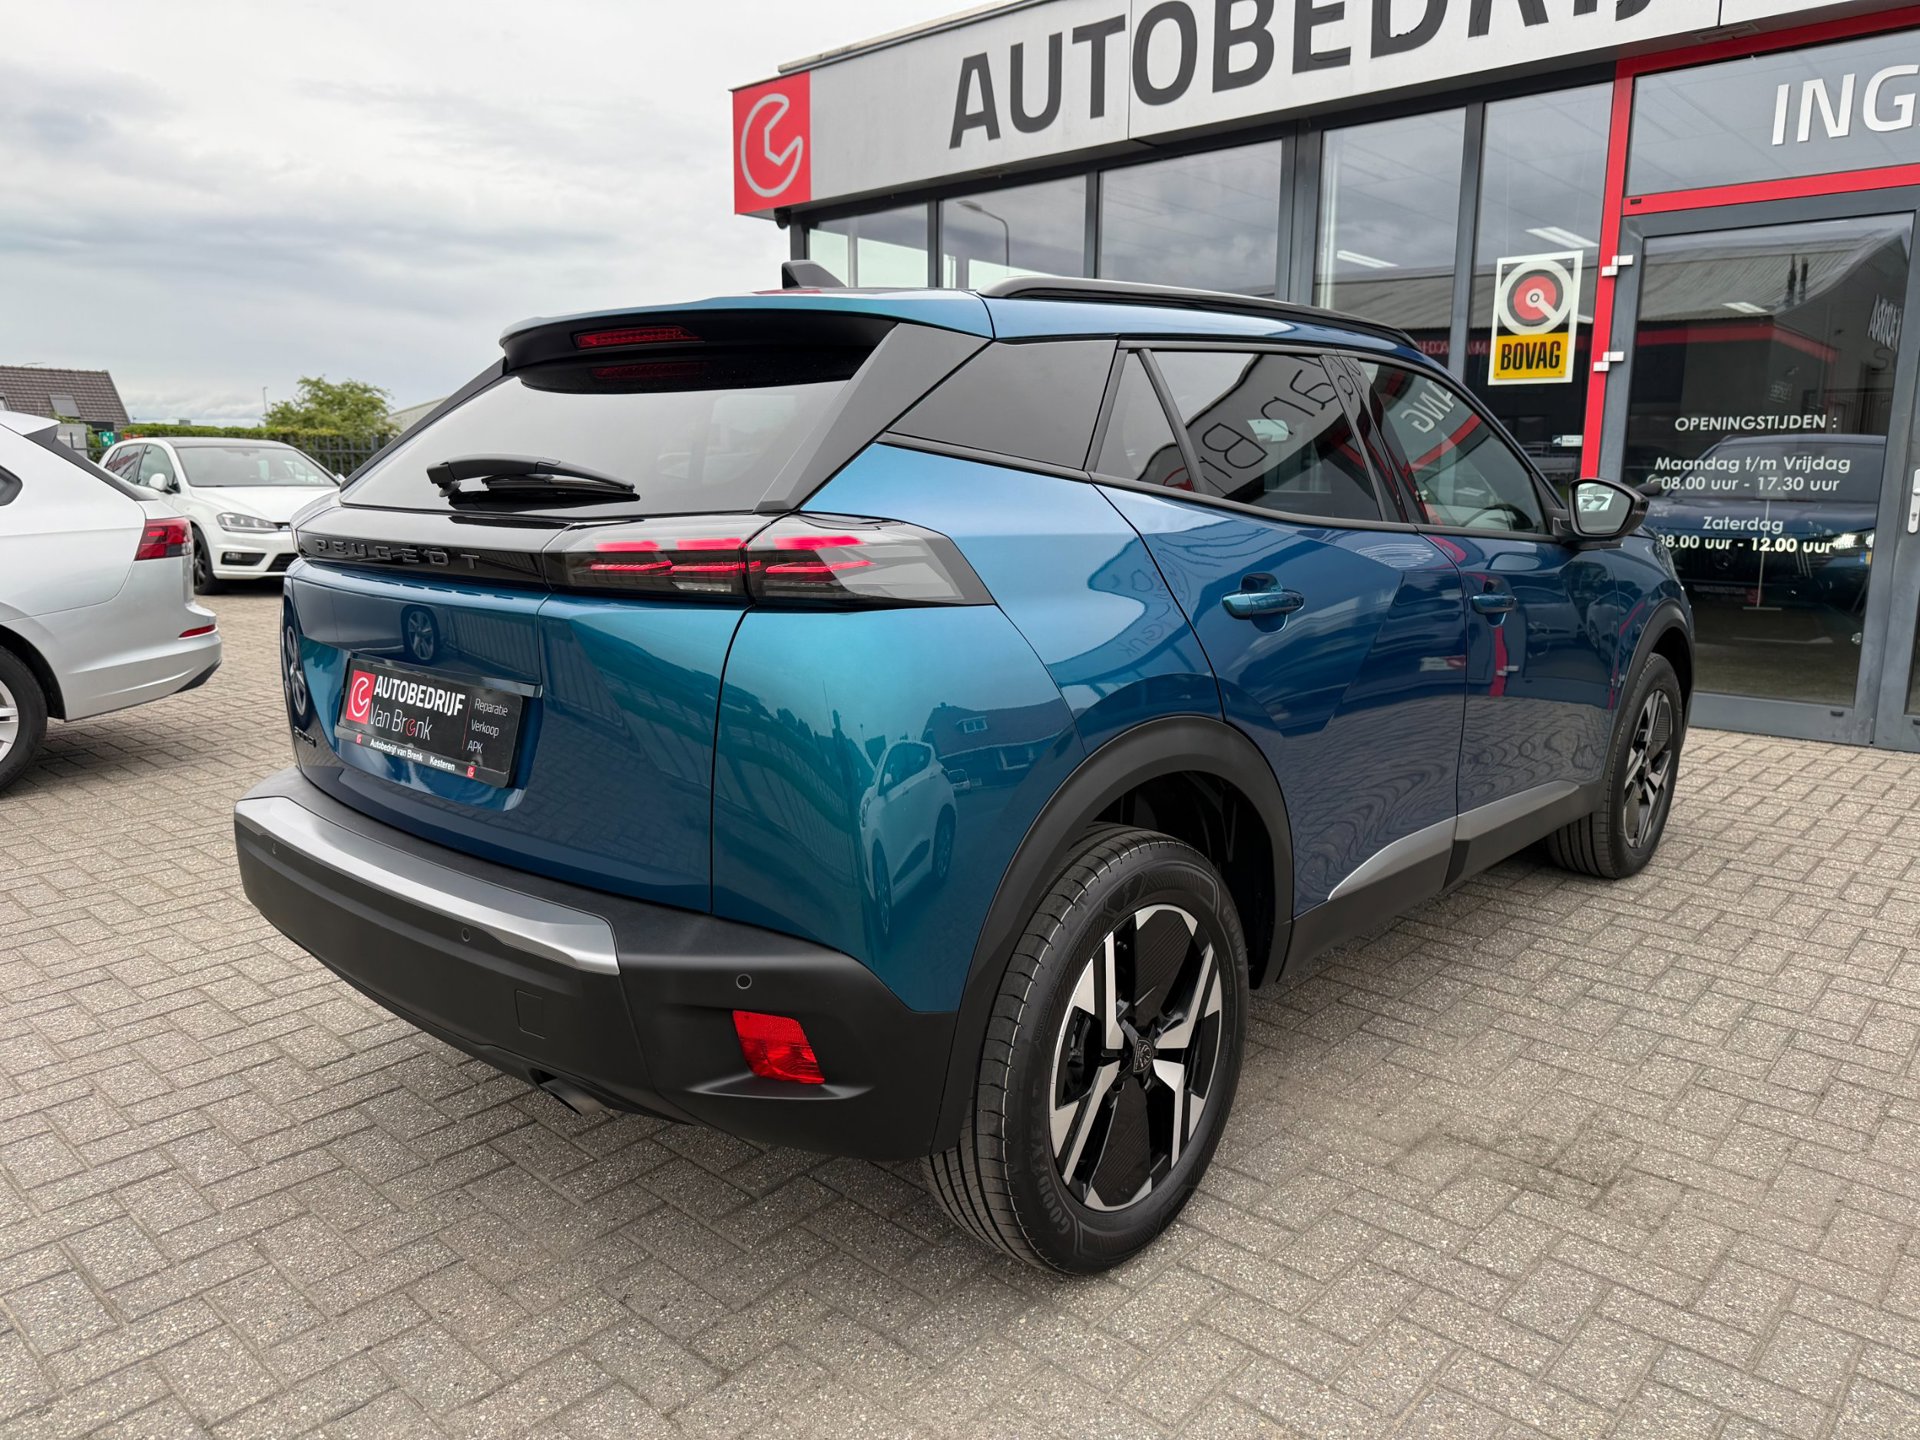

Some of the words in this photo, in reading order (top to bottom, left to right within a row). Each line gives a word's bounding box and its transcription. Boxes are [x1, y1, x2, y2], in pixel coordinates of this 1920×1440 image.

[948, 0, 1651, 150] AUTOBED
[1500, 339, 1561, 372] BOVAG
[1674, 414, 1827, 431] OPENINGSTIJDEN
[1654, 457, 1740, 474] Maandag
[1745, 457, 1777, 474] t/m
[1783, 457, 1851, 474] Vrijdag
[1661, 476, 1706, 491] 08.00
[1710, 478, 1739, 491] uur
[1757, 476, 1805, 492] 17.30
[1809, 477, 1840, 492] uur
[1703, 516, 1784, 534] Zaterdag
[315, 539, 480, 570] PEUGEOT
[1704, 537, 1733, 550] uur
[1751, 537, 1798, 553] 12.00
[1802, 539, 1833, 554] uur
[373, 675, 466, 716] AUTOBEDRIJF
[370, 702, 391, 729] Van
[474, 698, 509, 717] Reparatie
[471, 719, 500, 738] Verkoop
[370, 738, 397, 756] Autobedrijf
[397, 748, 406, 757] van
[406, 749, 423, 762] Brenk
[467, 740, 483, 754] APK
[429, 755, 456, 771] Kesteren
